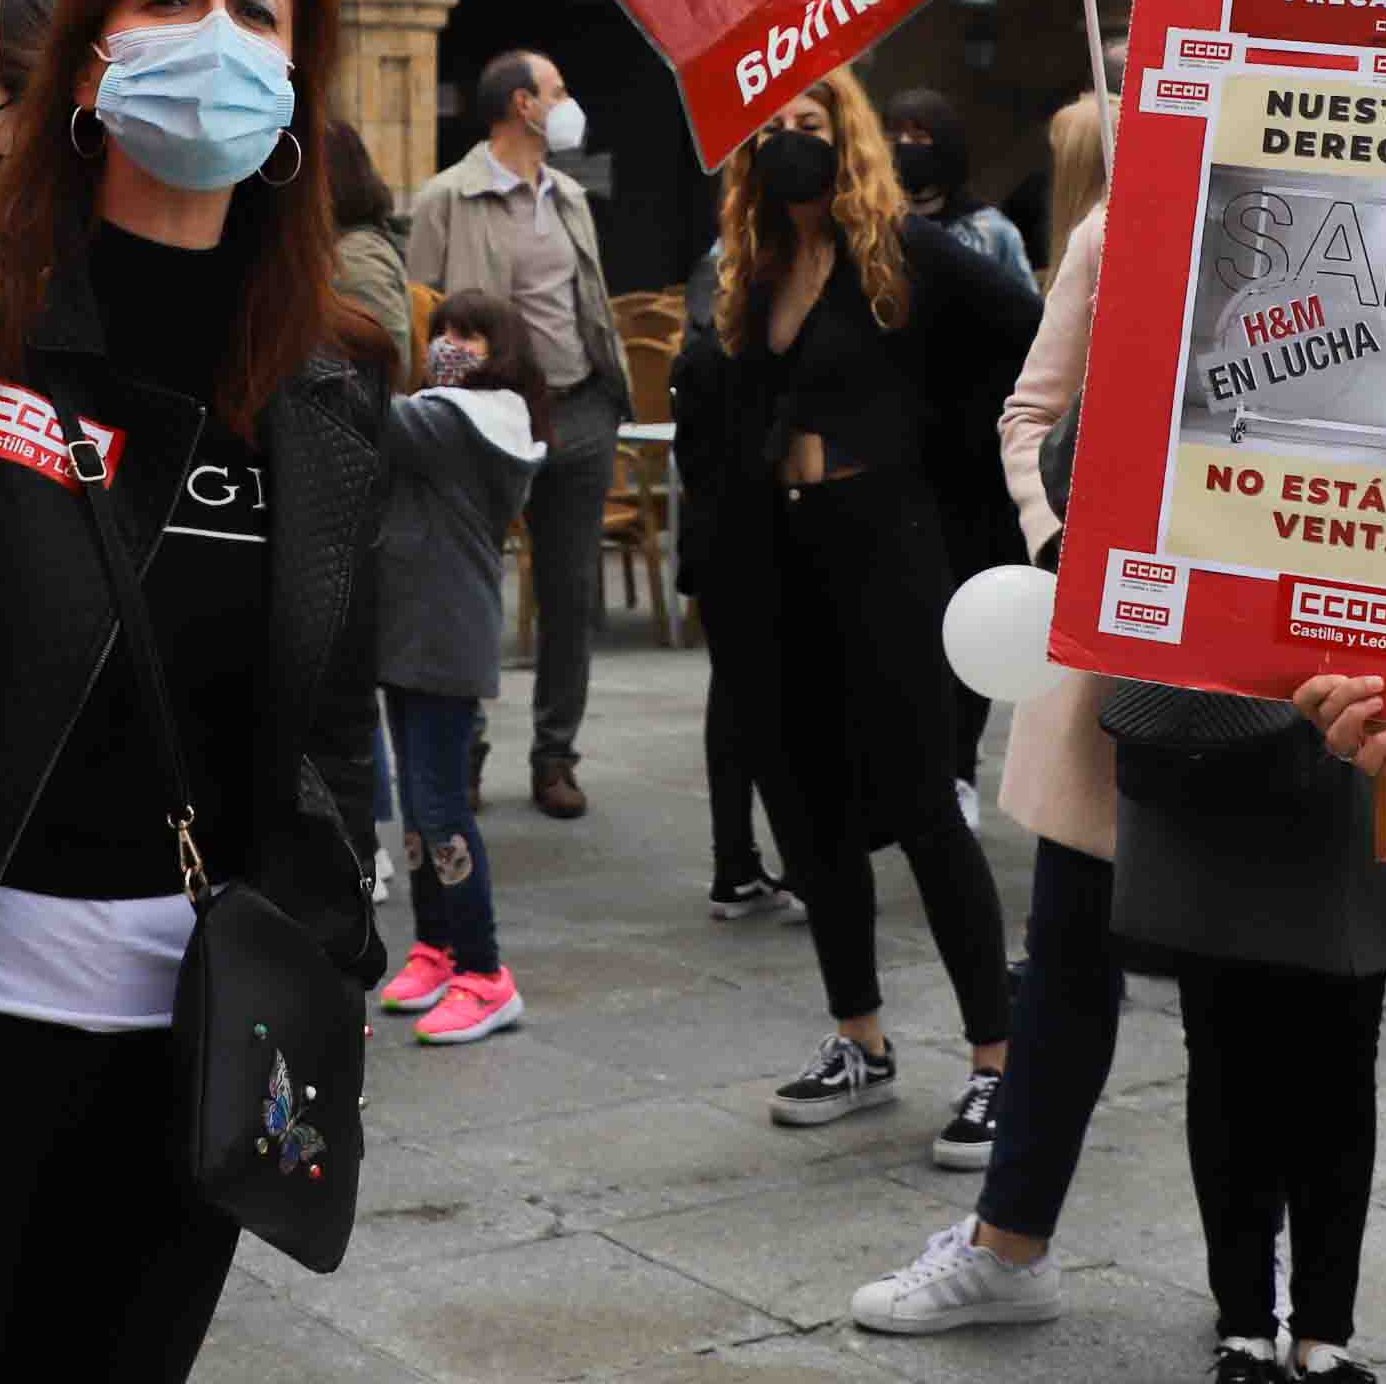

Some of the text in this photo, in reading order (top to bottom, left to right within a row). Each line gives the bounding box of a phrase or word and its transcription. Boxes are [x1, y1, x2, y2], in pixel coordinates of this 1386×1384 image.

[1242, 295, 1325, 347] H&M
[1208, 321, 1381, 401] EN LUCHA
[36, 453, 51, 467] y
[1206, 464, 1265, 496] NO
[1126, 562, 1174, 582] CCOO
[1119, 604, 1168, 623] CCOO
[1289, 622, 1343, 643] Castilla
[1346, 630, 1358, 647] y
